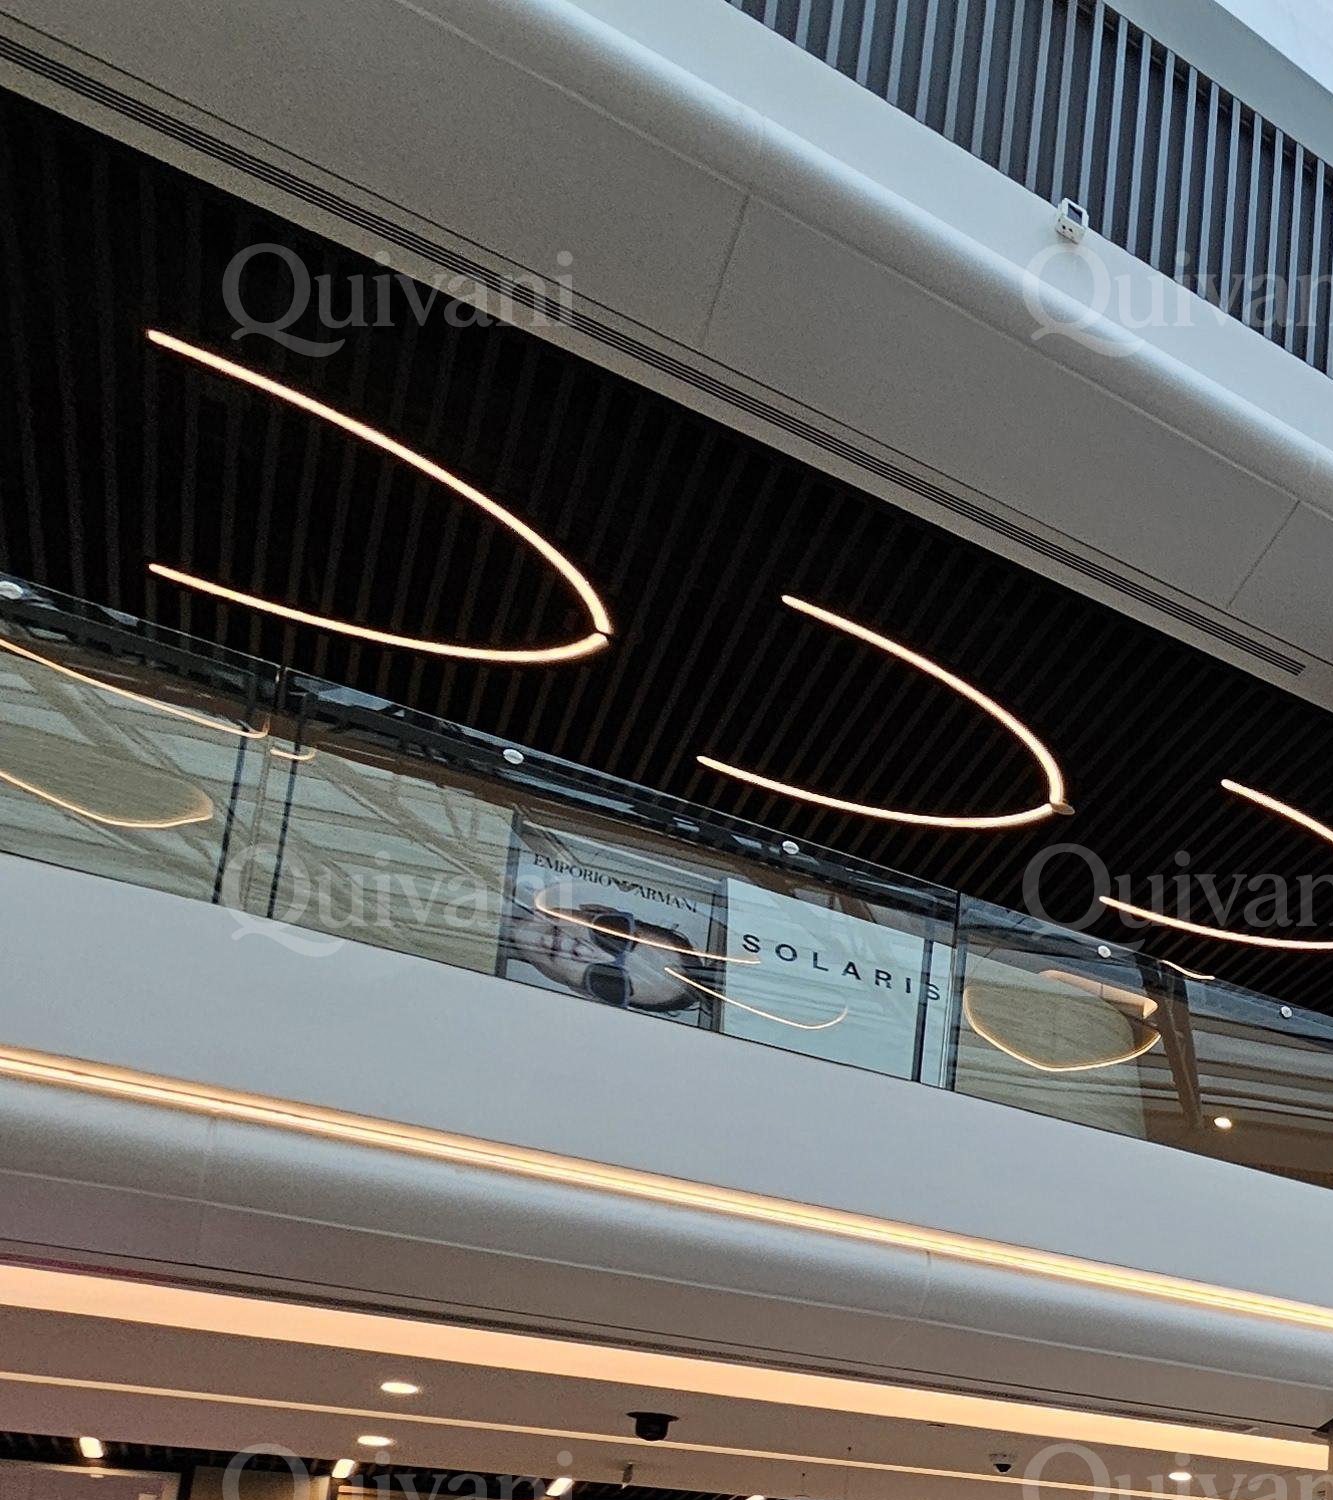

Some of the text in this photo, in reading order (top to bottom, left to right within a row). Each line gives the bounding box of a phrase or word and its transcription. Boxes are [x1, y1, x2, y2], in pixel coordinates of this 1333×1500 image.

[534, 853, 697, 913] EMPORIO ARMANI
[741, 934, 942, 1001] SOLARIS
